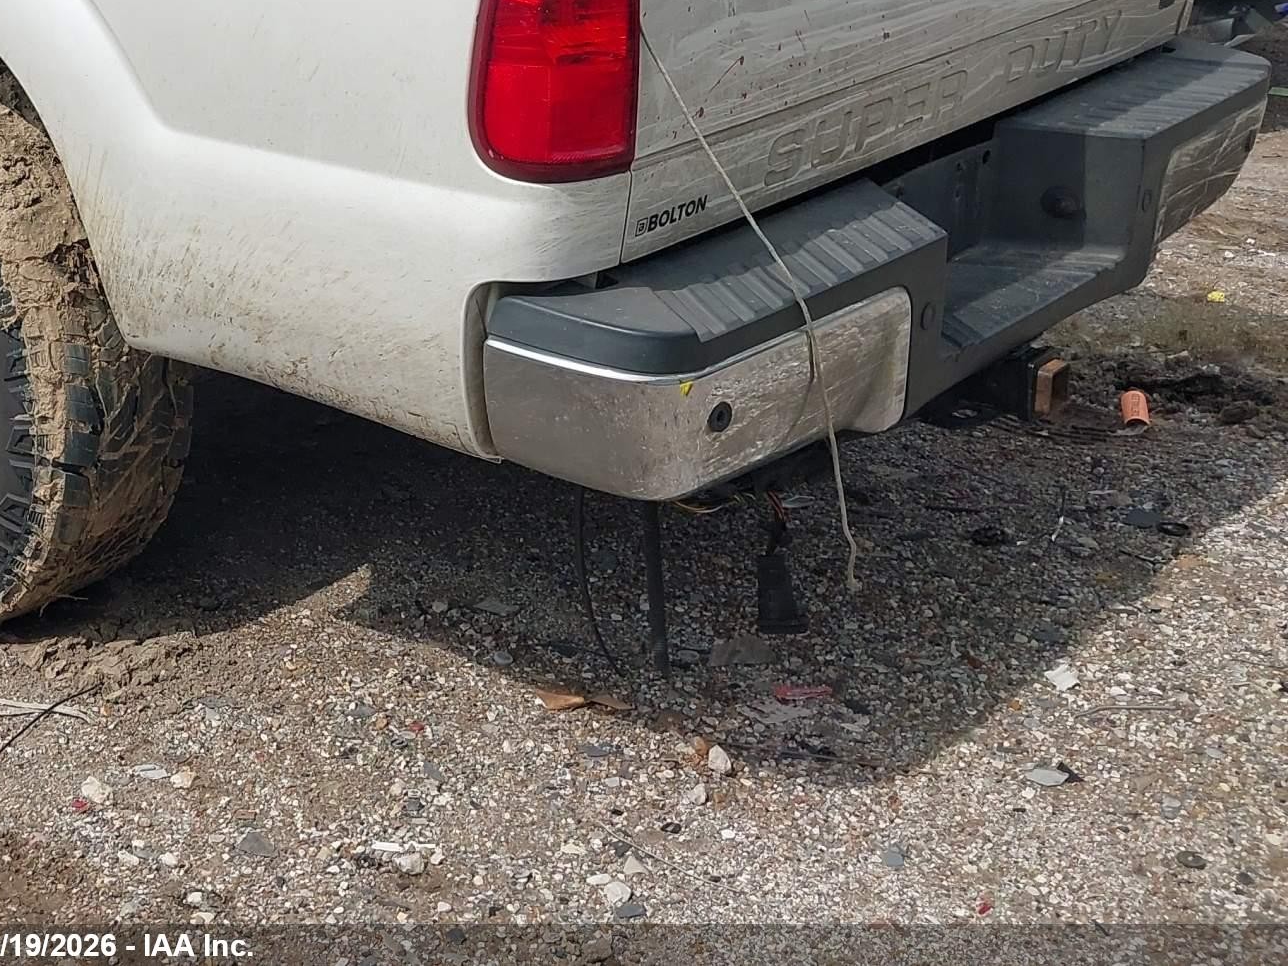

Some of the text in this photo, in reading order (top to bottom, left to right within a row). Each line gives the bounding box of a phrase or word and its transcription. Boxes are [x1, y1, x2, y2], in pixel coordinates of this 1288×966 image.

[764, 9, 1123, 186] SUPER DUTY
[646, 195, 708, 233] BOLTON
